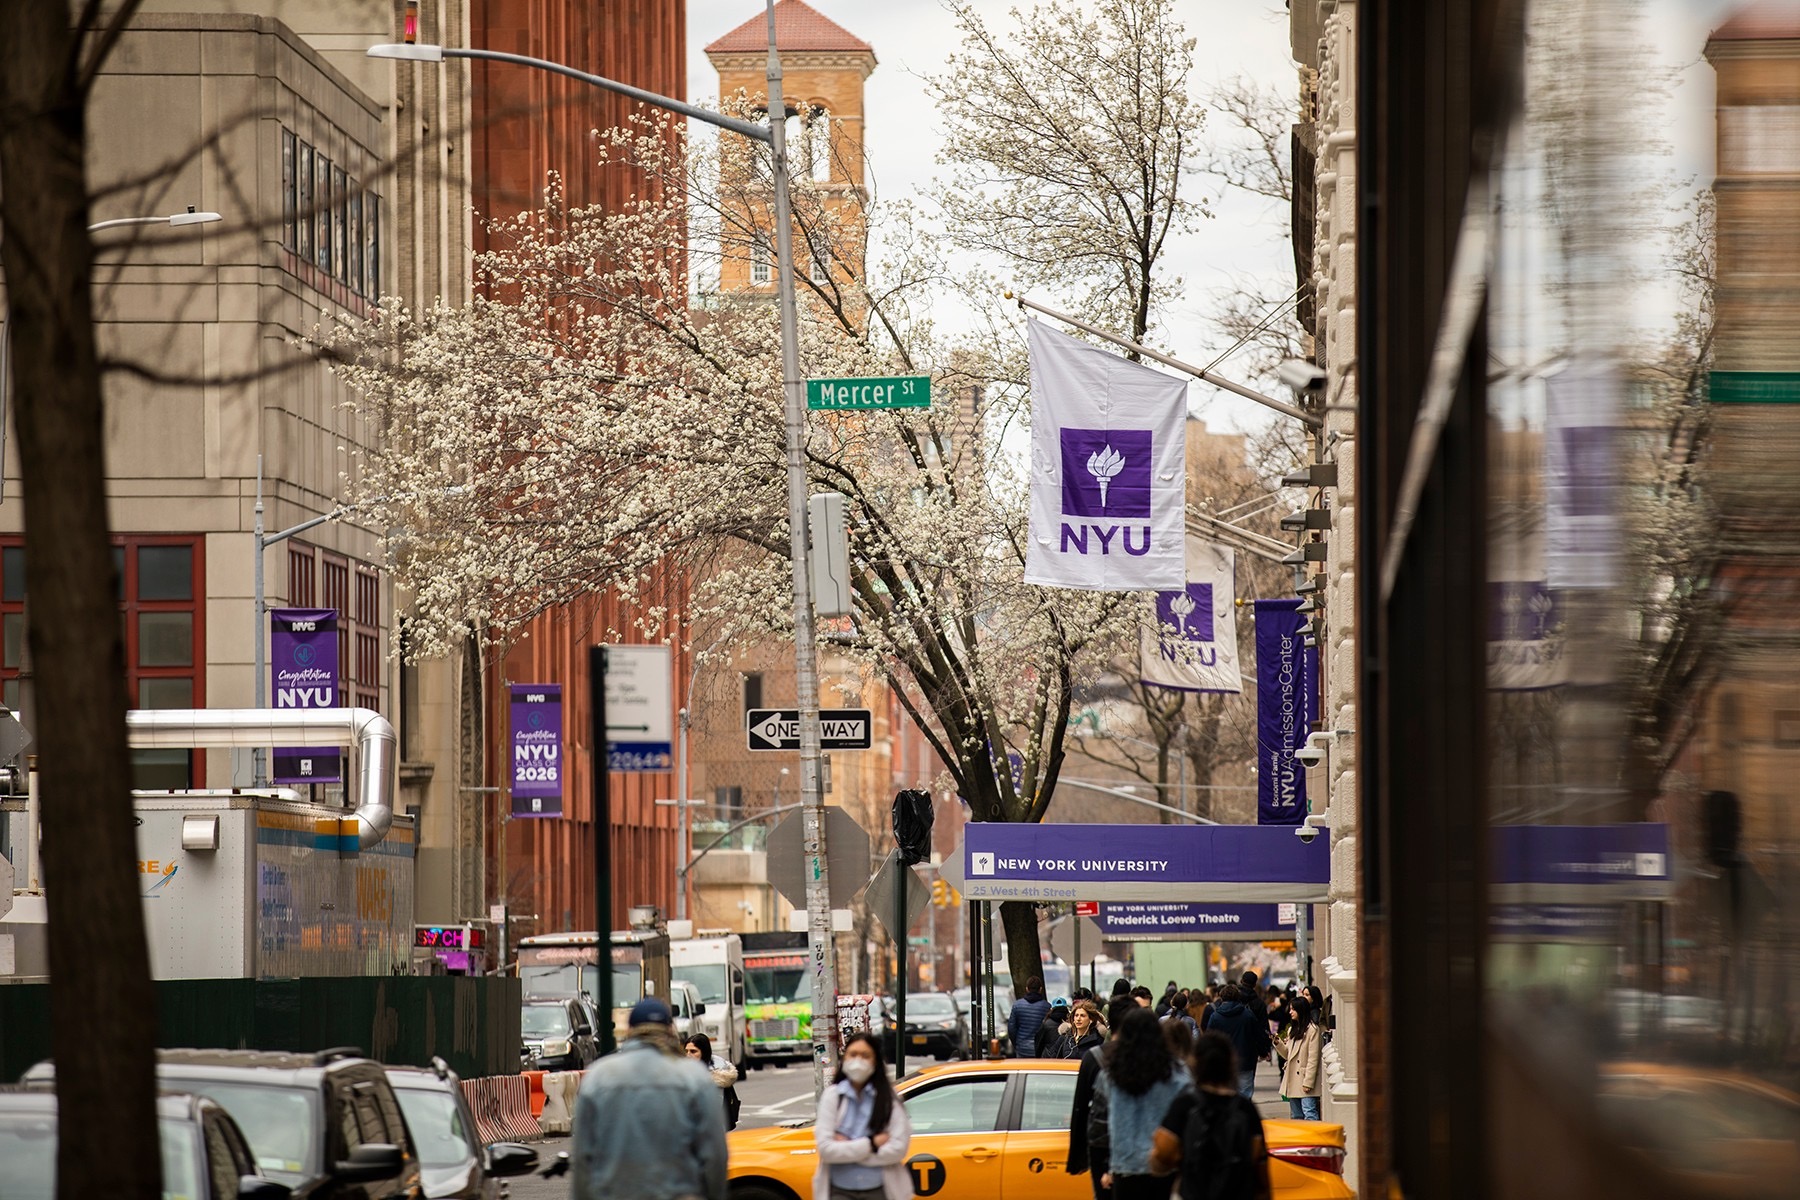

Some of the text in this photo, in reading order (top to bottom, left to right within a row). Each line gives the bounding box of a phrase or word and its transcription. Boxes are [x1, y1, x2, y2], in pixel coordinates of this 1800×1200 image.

[821, 380, 915, 405] Mercer St
[1060, 522, 1151, 556] NYU
[292, 621, 316, 632] NYC
[277, 687, 333, 708] NYU
[765, 722, 860, 738] ONE WAY
[515, 744, 558, 761] NYU
[515, 767, 558, 781] 2026
[1271, 751, 1281, 807] Bonomi Family
[998, 858, 1169, 872] NEW YORK UNIVERSITY
[973, 886, 1077, 898] 25 West 4th Street
[1147, 904, 1189, 912] UNIVERSITY
[1107, 913, 1240, 925] Frederick Loewe Theatre
[912, 1161, 937, 1191] T
